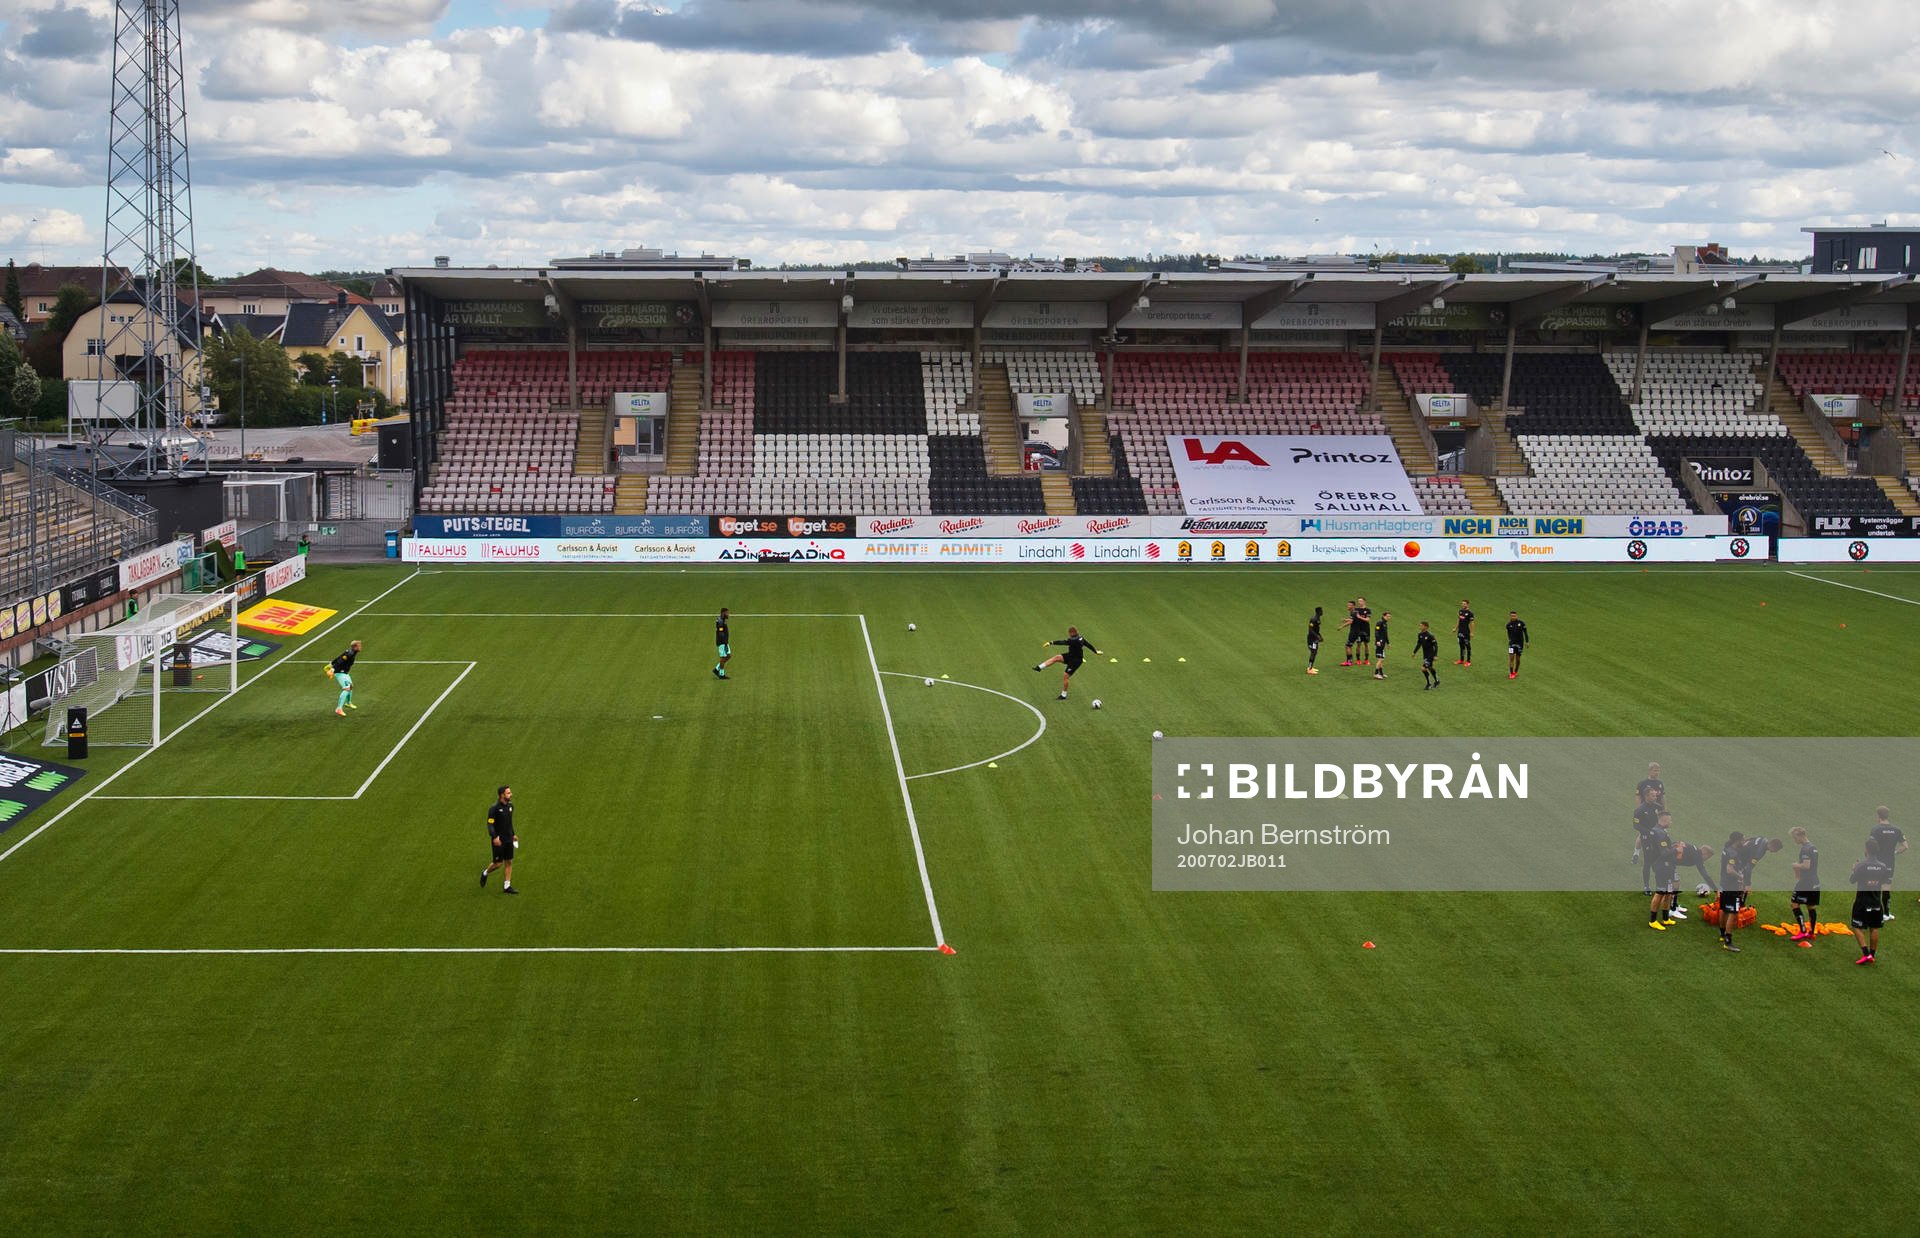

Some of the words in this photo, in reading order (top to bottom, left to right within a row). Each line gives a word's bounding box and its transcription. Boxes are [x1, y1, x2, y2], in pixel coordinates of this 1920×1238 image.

[1289, 447, 1393, 464] Printoz
[1189, 496, 1243, 505] Carlsson
[1246, 496, 1254, 504] &
[1318, 489, 1396, 501] ÖREBRO
[1314, 502, 1412, 512] SALUHALL
[870, 518, 915, 534] Radiator
[940, 518, 985, 534] Radiator
[1017, 518, 1063, 534] Radiator
[1087, 518, 1132, 534] Radiator
[1326, 520, 1433, 534] HusmanHagberg
[1628, 516, 1684, 536] ÖBAB
[1815, 517, 1851, 530] FLEX
[419, 545, 467, 556] FALUHUS
[492, 545, 540, 556] FALUHUS
[634, 545, 665, 553] Carlsson
[865, 543, 919, 556] ADMIT
[940, 543, 994, 556] ADMIT
[1019, 545, 1066, 558] Lindahl
[1094, 545, 1141, 558] Lindahl
[1312, 544, 1359, 555] Bergslagens
[1360, 544, 1397, 555] Sparbank
[1460, 545, 1492, 554] Bonum
[1521, 545, 1553, 554] Bonum
